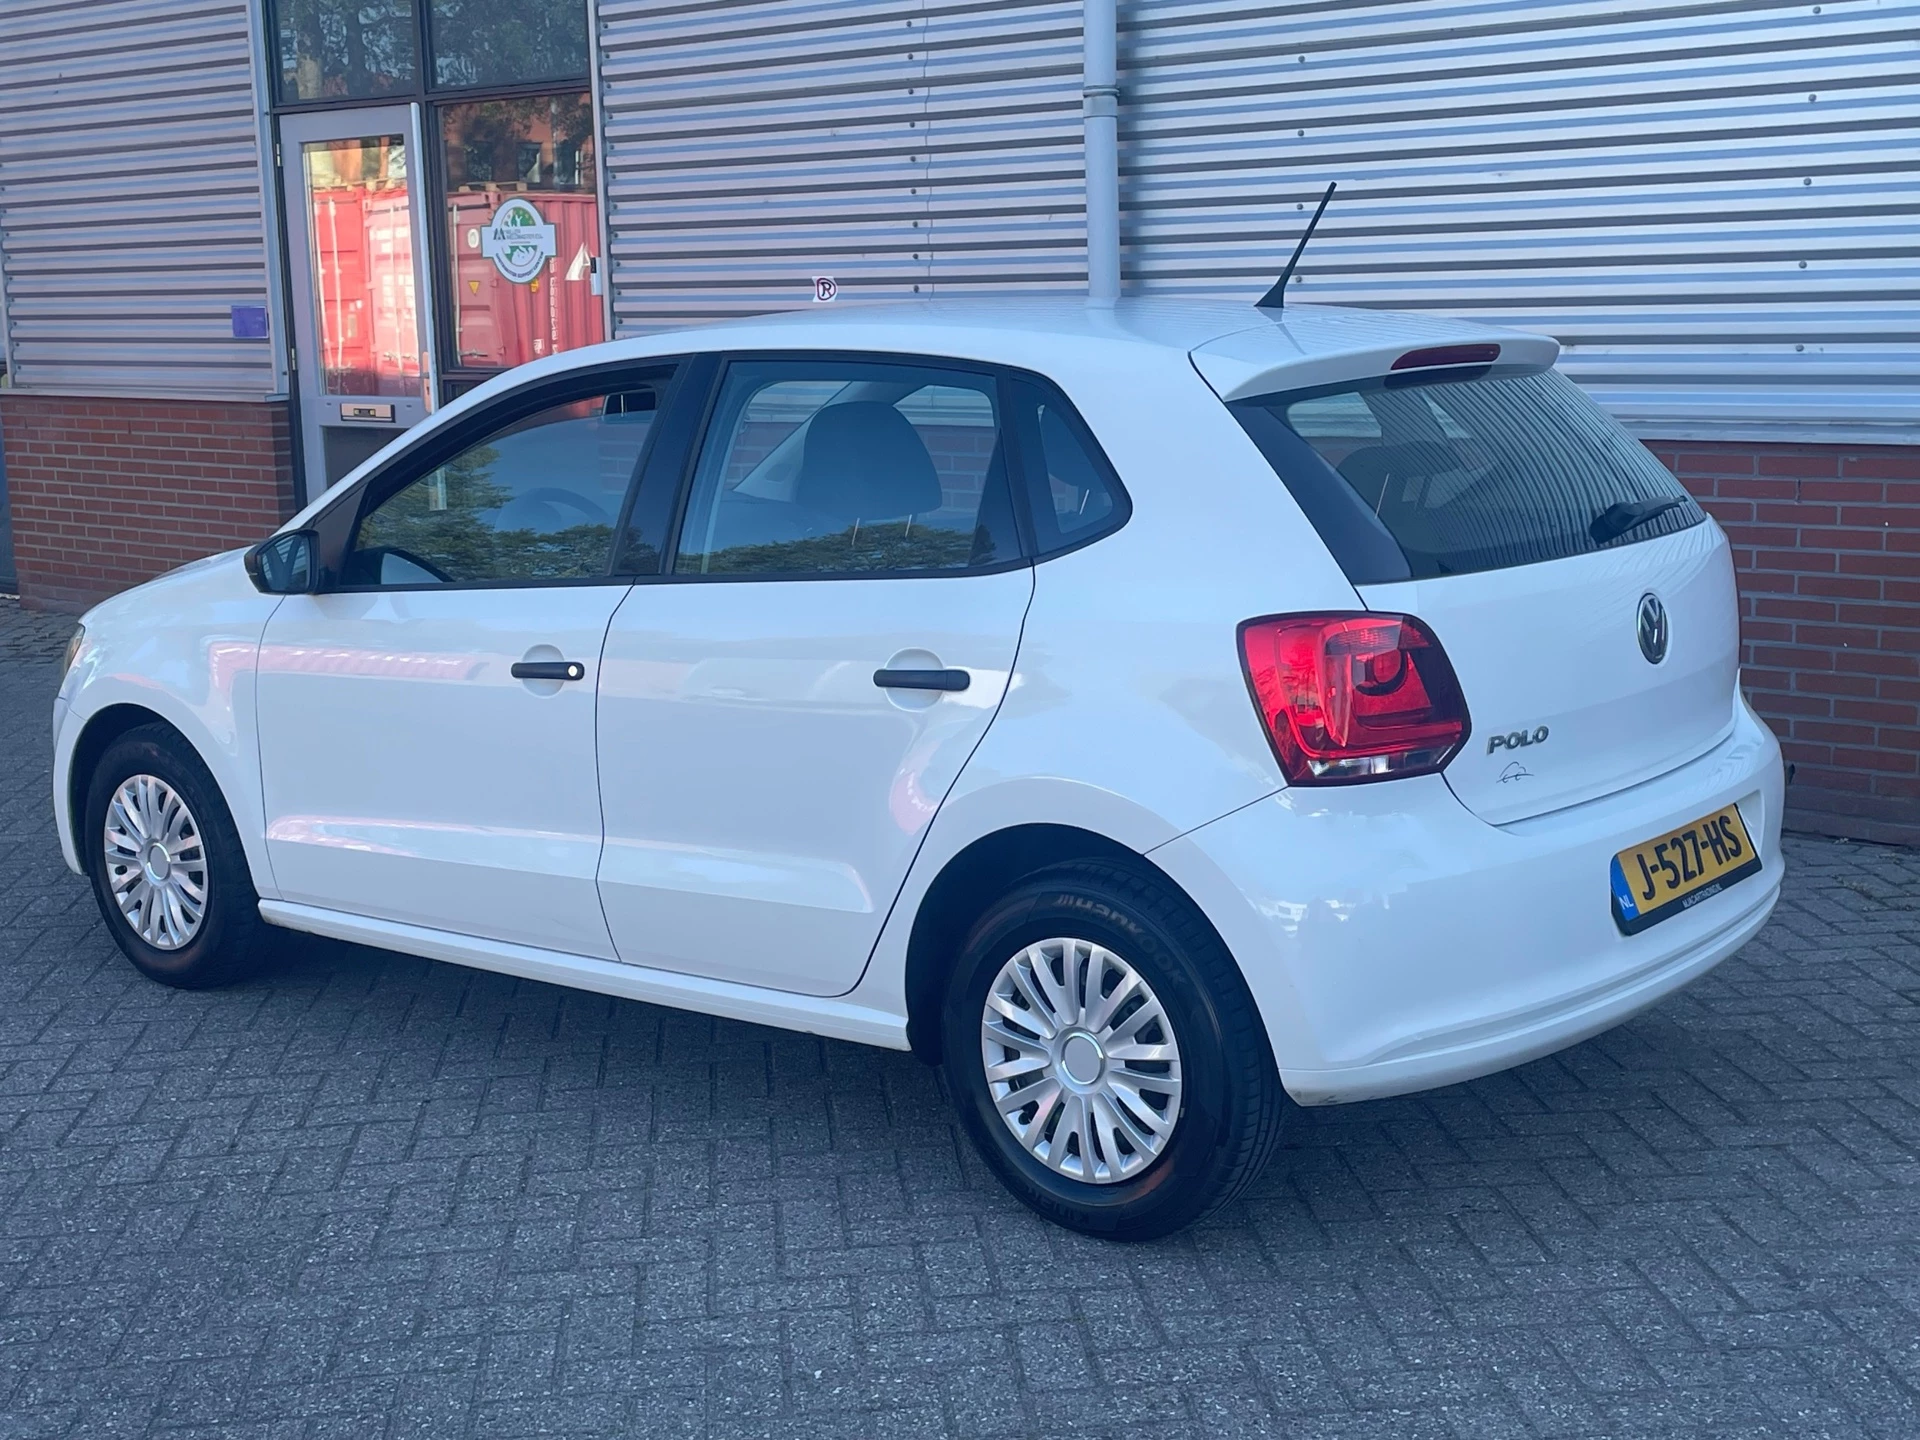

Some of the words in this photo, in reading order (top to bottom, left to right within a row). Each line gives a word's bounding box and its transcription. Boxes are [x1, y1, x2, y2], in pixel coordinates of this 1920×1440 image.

[1487, 726, 1549, 754] POLO
[1636, 815, 1742, 901] J-527-HS
[1618, 895, 1634, 910] NL
